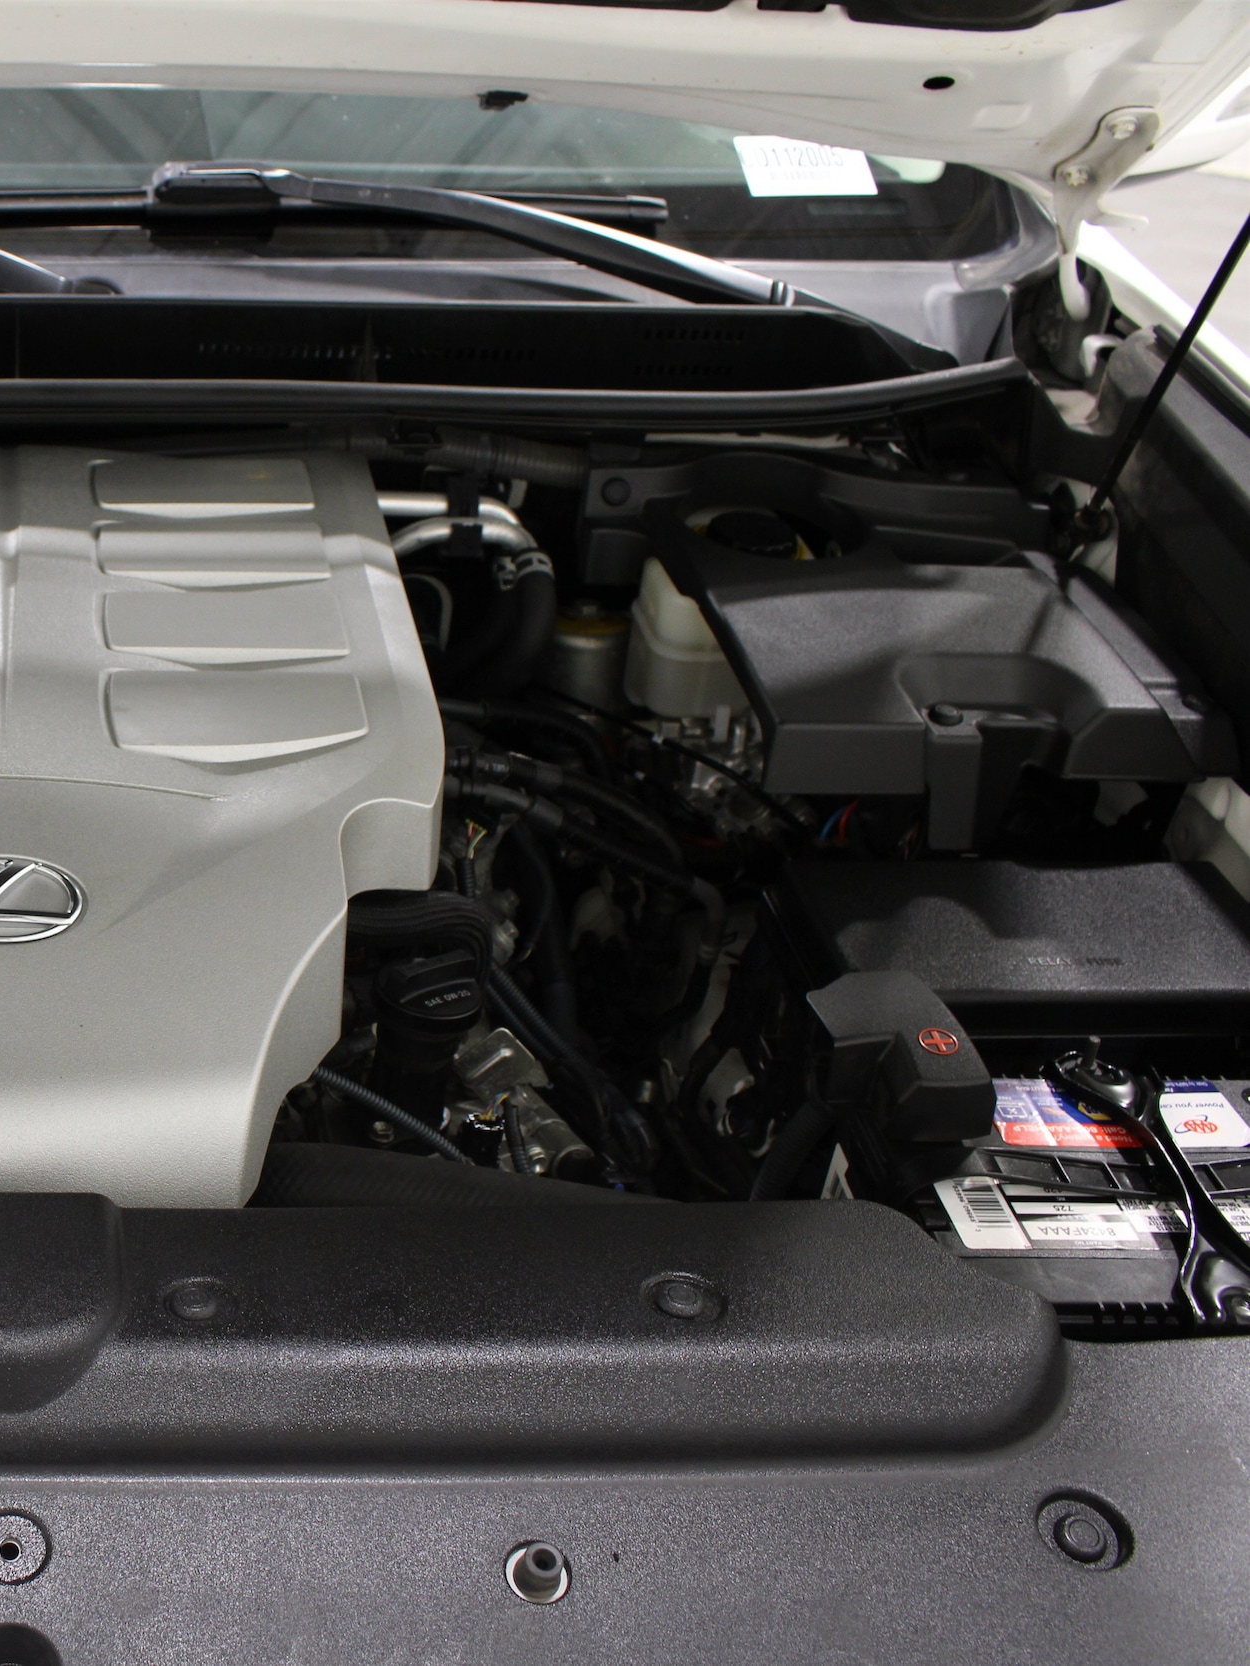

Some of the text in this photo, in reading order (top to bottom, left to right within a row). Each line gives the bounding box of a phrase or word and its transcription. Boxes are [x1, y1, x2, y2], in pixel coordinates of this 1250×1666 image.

[1028, 957, 1127, 966] RELAY FUSE
[424, 989, 471, 1008] SAE 0W-20
[1184, 1119, 1218, 1133] AAA
[1053, 1204, 1074, 1212] 725
[1037, 1226, 1117, 1237] 8424FAAA
